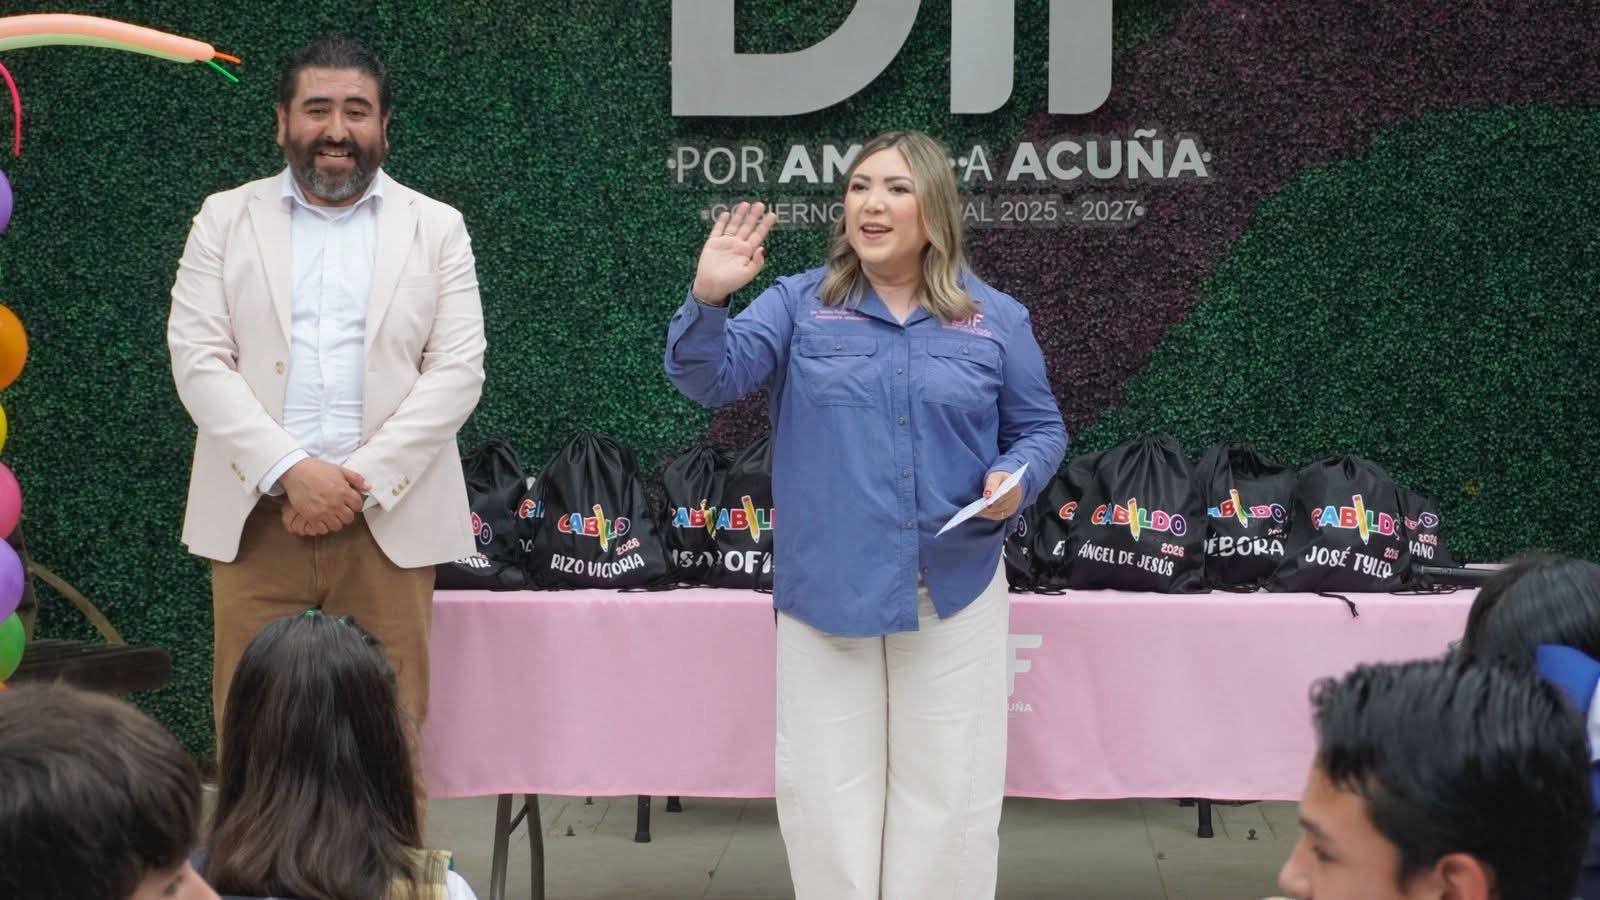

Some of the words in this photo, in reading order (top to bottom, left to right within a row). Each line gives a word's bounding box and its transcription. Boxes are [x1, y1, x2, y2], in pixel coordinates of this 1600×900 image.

[677, 146, 765, 184] POR
[778, 144, 861, 184] AM
[963, 145, 992, 181] A
[1006, 129, 1208, 181] ACUÑA
[1001, 201, 1057, 222] 2025
[1082, 200, 1137, 222] 2027
[1091, 498, 1187, 541] CABILDO
[1078, 540, 1115, 564] ÁNGEL
[1118, 550, 1135, 566] DE
[1137, 556, 1175, 577] JESÚS
[1161, 543, 1184, 558] 2026
[1305, 545, 1351, 567] JOSÉ
[550, 553, 585, 575] RIZO
